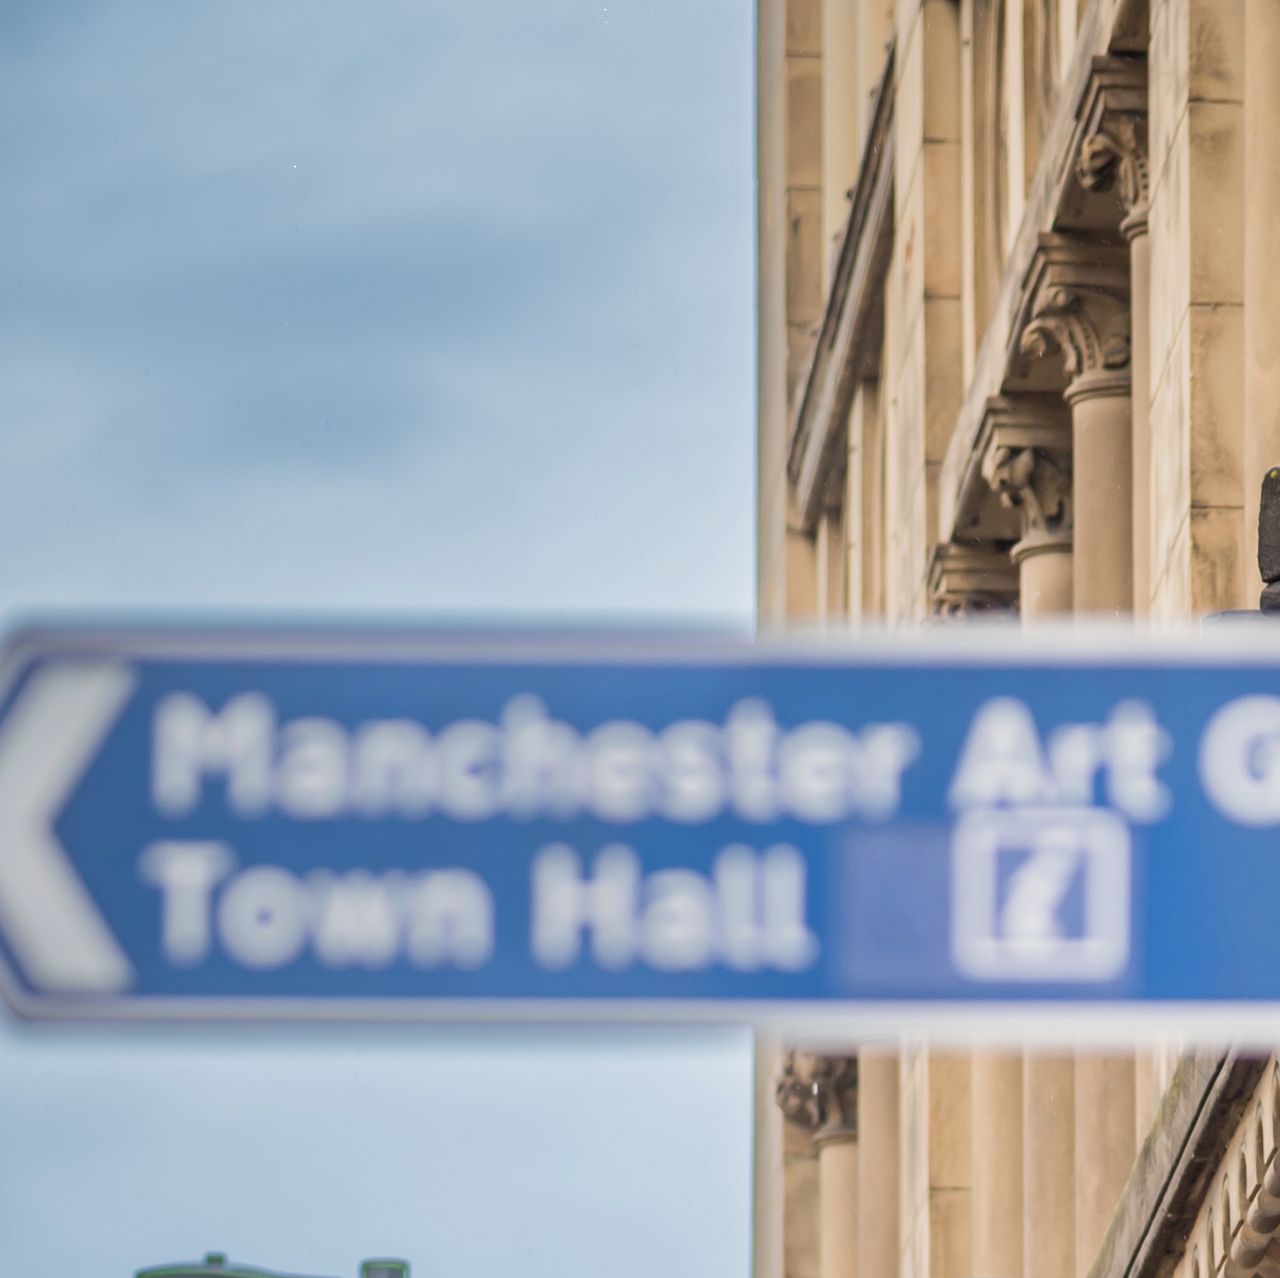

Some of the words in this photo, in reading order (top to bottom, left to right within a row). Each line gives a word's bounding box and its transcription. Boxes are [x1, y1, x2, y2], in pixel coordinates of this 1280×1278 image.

[154, 693, 918, 822] Manchester
[951, 697, 1168, 823] Art
[140, 841, 495, 970] Town
[531, 844, 817, 971] Hall
